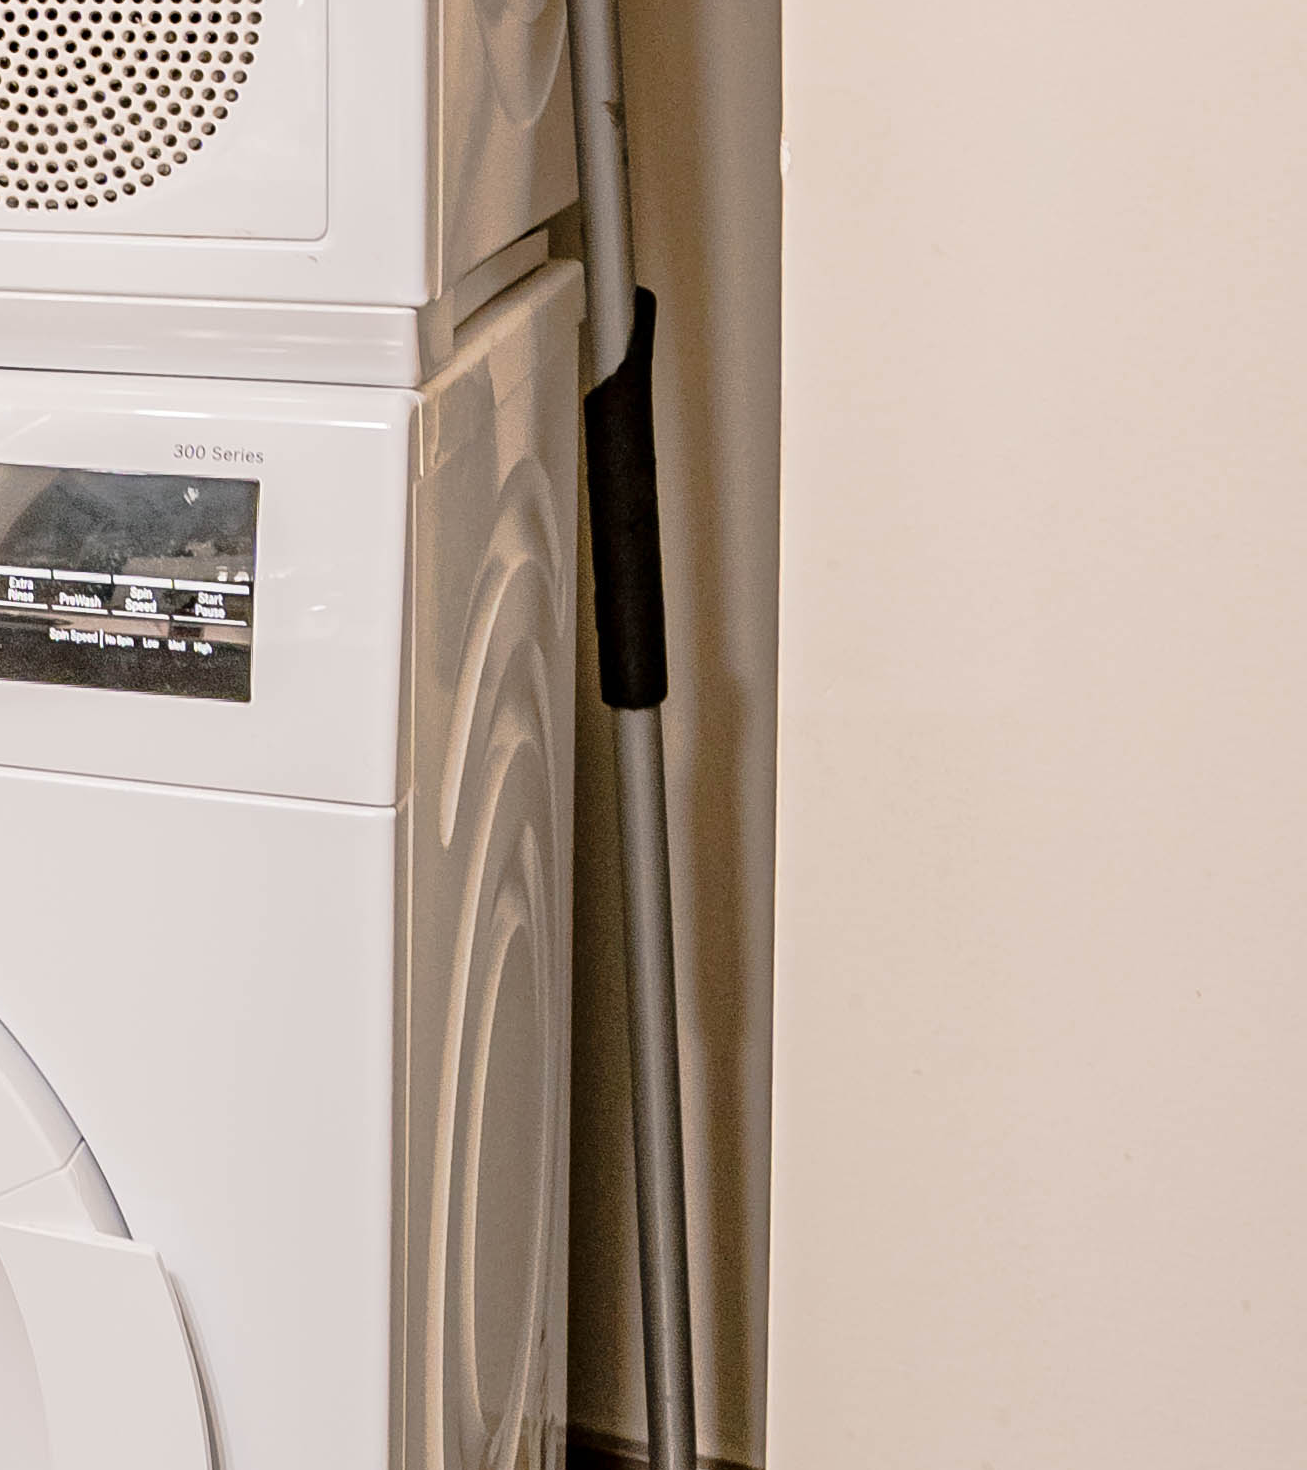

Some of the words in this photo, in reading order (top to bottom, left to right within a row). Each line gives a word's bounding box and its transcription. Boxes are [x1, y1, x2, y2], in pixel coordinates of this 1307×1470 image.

[173, 443, 206, 460] 300
[211, 446, 265, 464] Series
[9, 576, 34, 591] Extra
[7, 588, 35, 603] Rinse
[129, 586, 153, 601] Spin
[198, 592, 224, 606] Start
[125, 598, 157, 613] Speed
[195, 604, 226, 619] Pause
[49, 627, 69, 642] Spin
[70, 628, 98, 644] Speed
